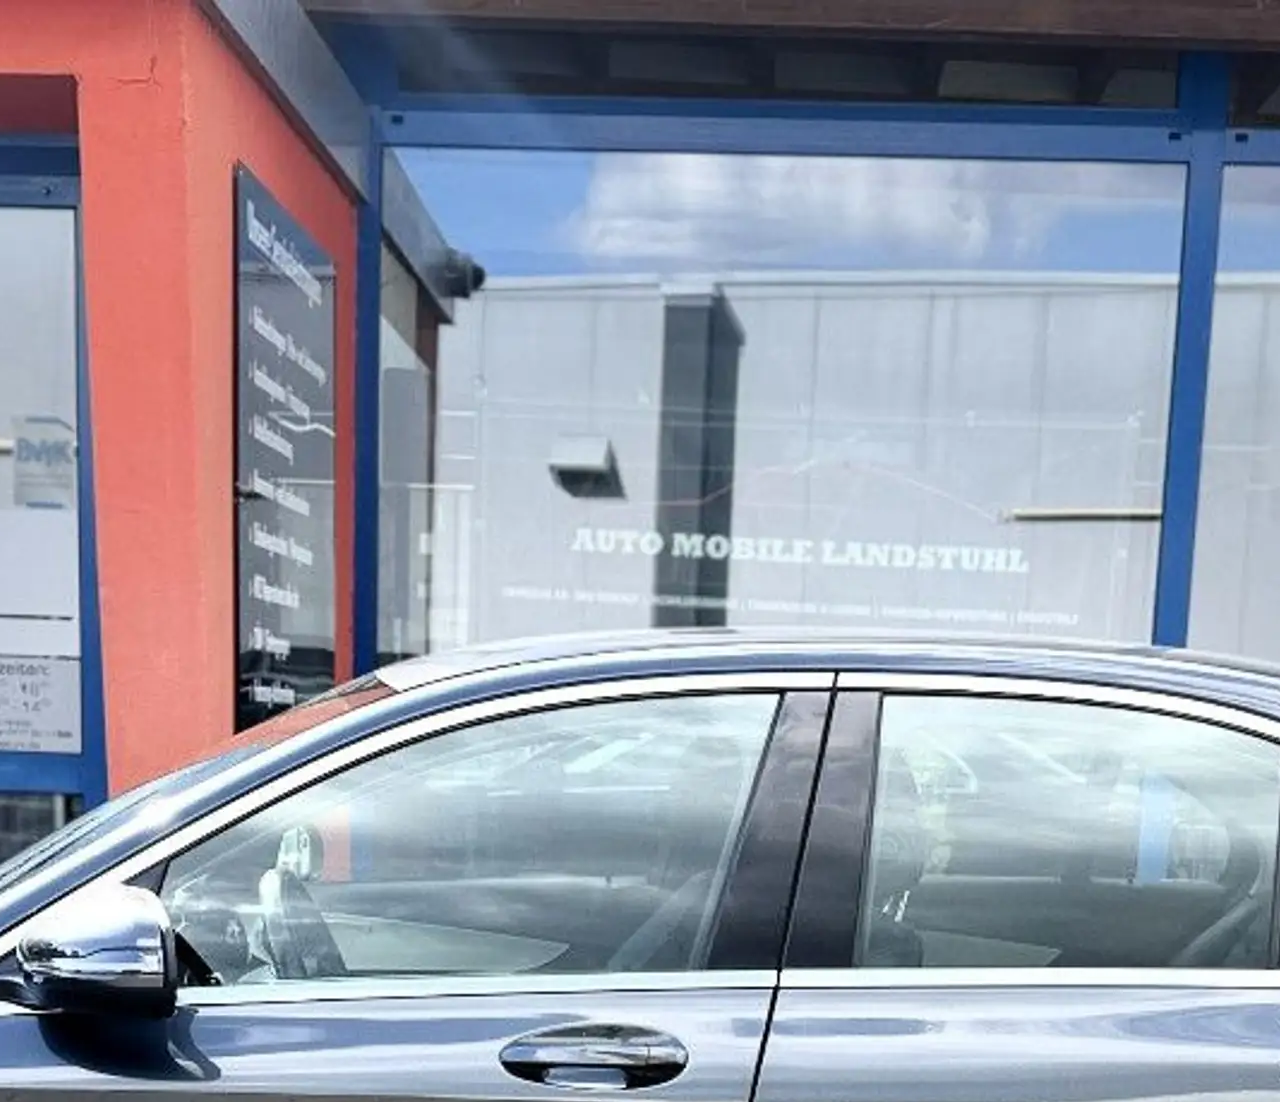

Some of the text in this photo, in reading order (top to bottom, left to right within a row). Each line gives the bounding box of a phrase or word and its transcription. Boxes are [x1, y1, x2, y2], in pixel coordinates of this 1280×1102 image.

[572, 528, 1029, 573] AUTO MOBILE LANDSTUHL
